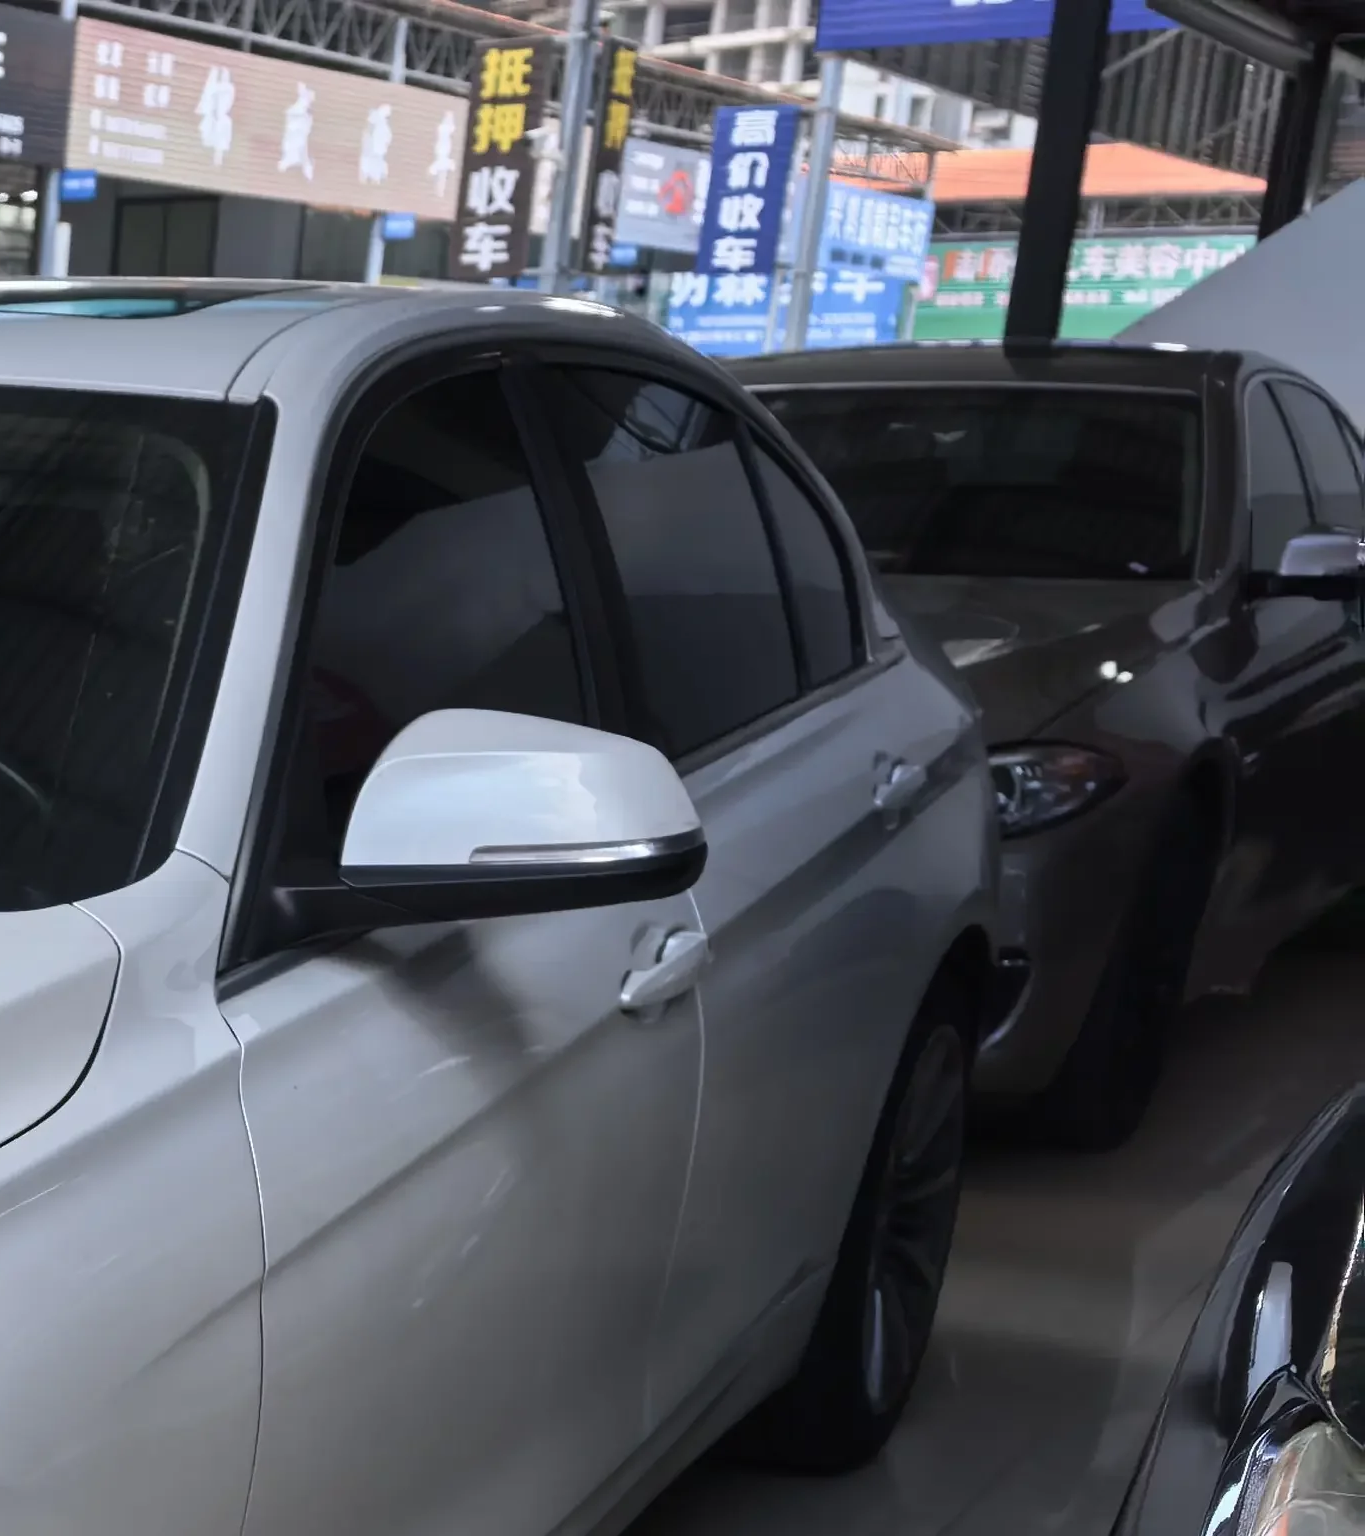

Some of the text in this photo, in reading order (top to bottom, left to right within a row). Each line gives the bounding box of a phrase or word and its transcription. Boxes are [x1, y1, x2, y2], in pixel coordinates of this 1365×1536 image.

[459, 48, 534, 273] 抵押收车
[711, 109, 780, 271] 高价收车
